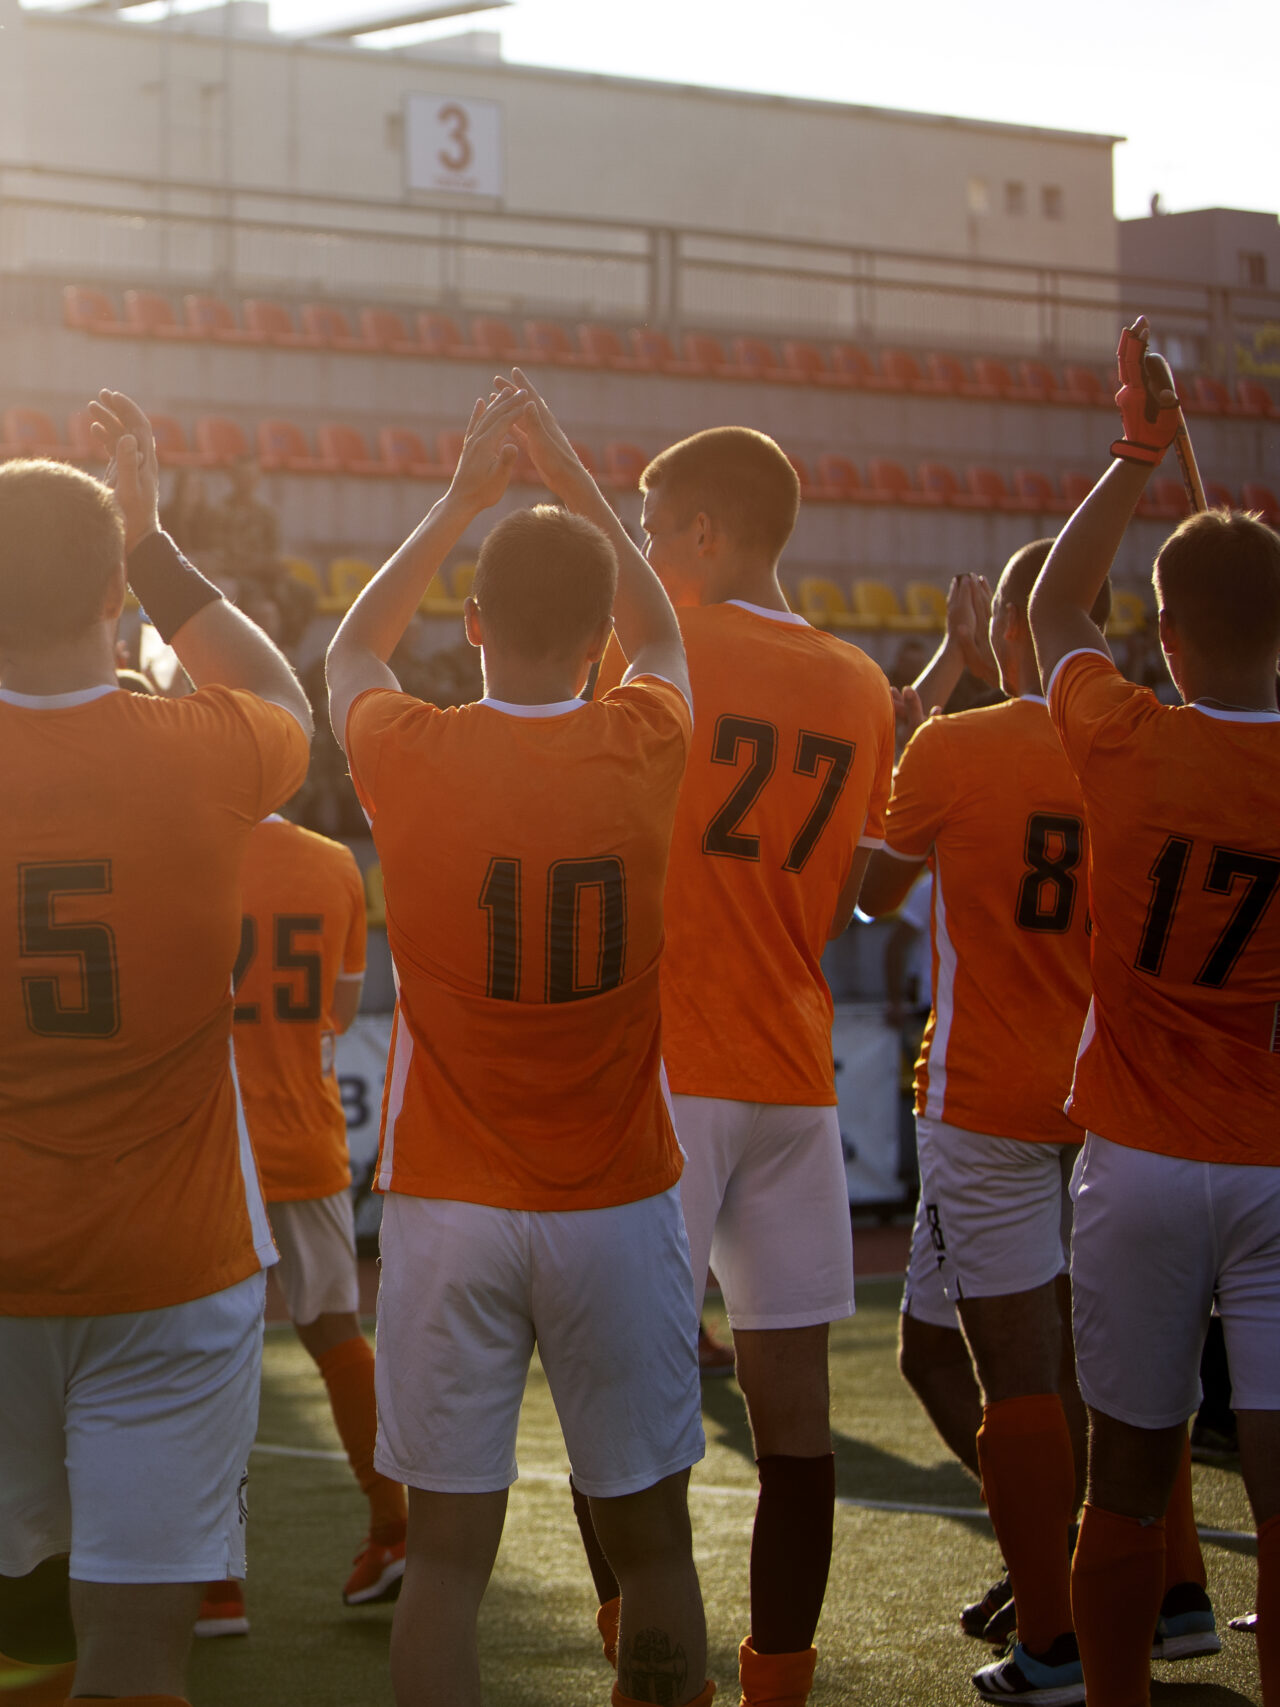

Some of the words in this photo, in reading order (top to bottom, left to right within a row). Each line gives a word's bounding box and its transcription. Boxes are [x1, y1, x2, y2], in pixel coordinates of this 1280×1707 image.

[436, 102, 475, 173] 3
[702, 713, 856, 874] 27
[18, 859, 119, 1038] 5
[478, 855, 628, 1004] 10
[1015, 811, 1093, 937] 8
[1134, 836, 1280, 990] 17
